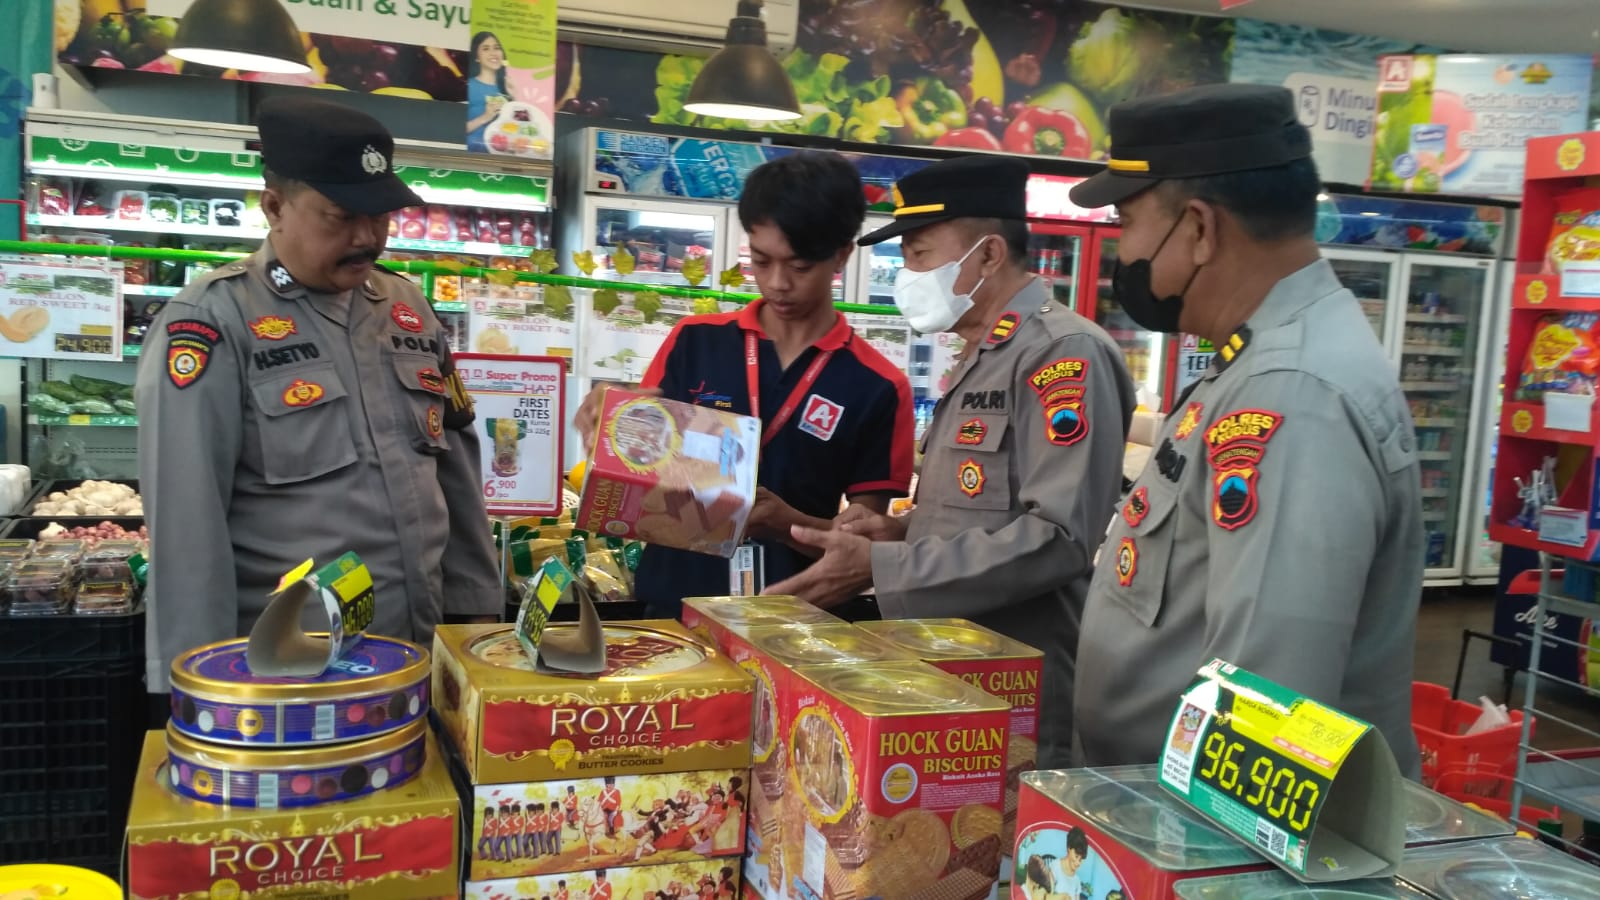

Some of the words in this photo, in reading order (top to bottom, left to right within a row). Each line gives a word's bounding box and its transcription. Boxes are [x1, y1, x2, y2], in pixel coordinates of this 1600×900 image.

[373, 0, 397, 16] &
[408, 2, 471, 28] Sayu
[1327, 88, 1377, 111] Minu
[1325, 111, 1377, 140] Dingi
[41, 300, 89, 310] SWEET
[390, 335, 439, 356] POLR
[1187, 355, 1210, 370] TE
[486, 370, 518, 382] Super
[521, 371, 557, 382] Promo
[1032, 360, 1084, 387] POLRES
[1042, 370, 1076, 387] KUDUS
[519, 397, 551, 409] FIRST
[961, 389, 1008, 410] POLRI
[513, 408, 550, 420] DATES
[1208, 412, 1275, 444] POLRES
[989, 670, 1039, 692] GUAN
[550, 703, 696, 736] ROYAL
[589, 731, 663, 746] CHOICE
[879, 731, 941, 757] HOCK
[945, 727, 1005, 754] GUAN
[577, 758, 618, 770] BUTTER
[619, 756, 664, 768] COOKIES
[923, 754, 1003, 774] BISCUITS
[1200, 731, 1321, 832] 96.900
[208, 833, 384, 878] ROYAL
[256, 866, 345, 884] CHOICE
